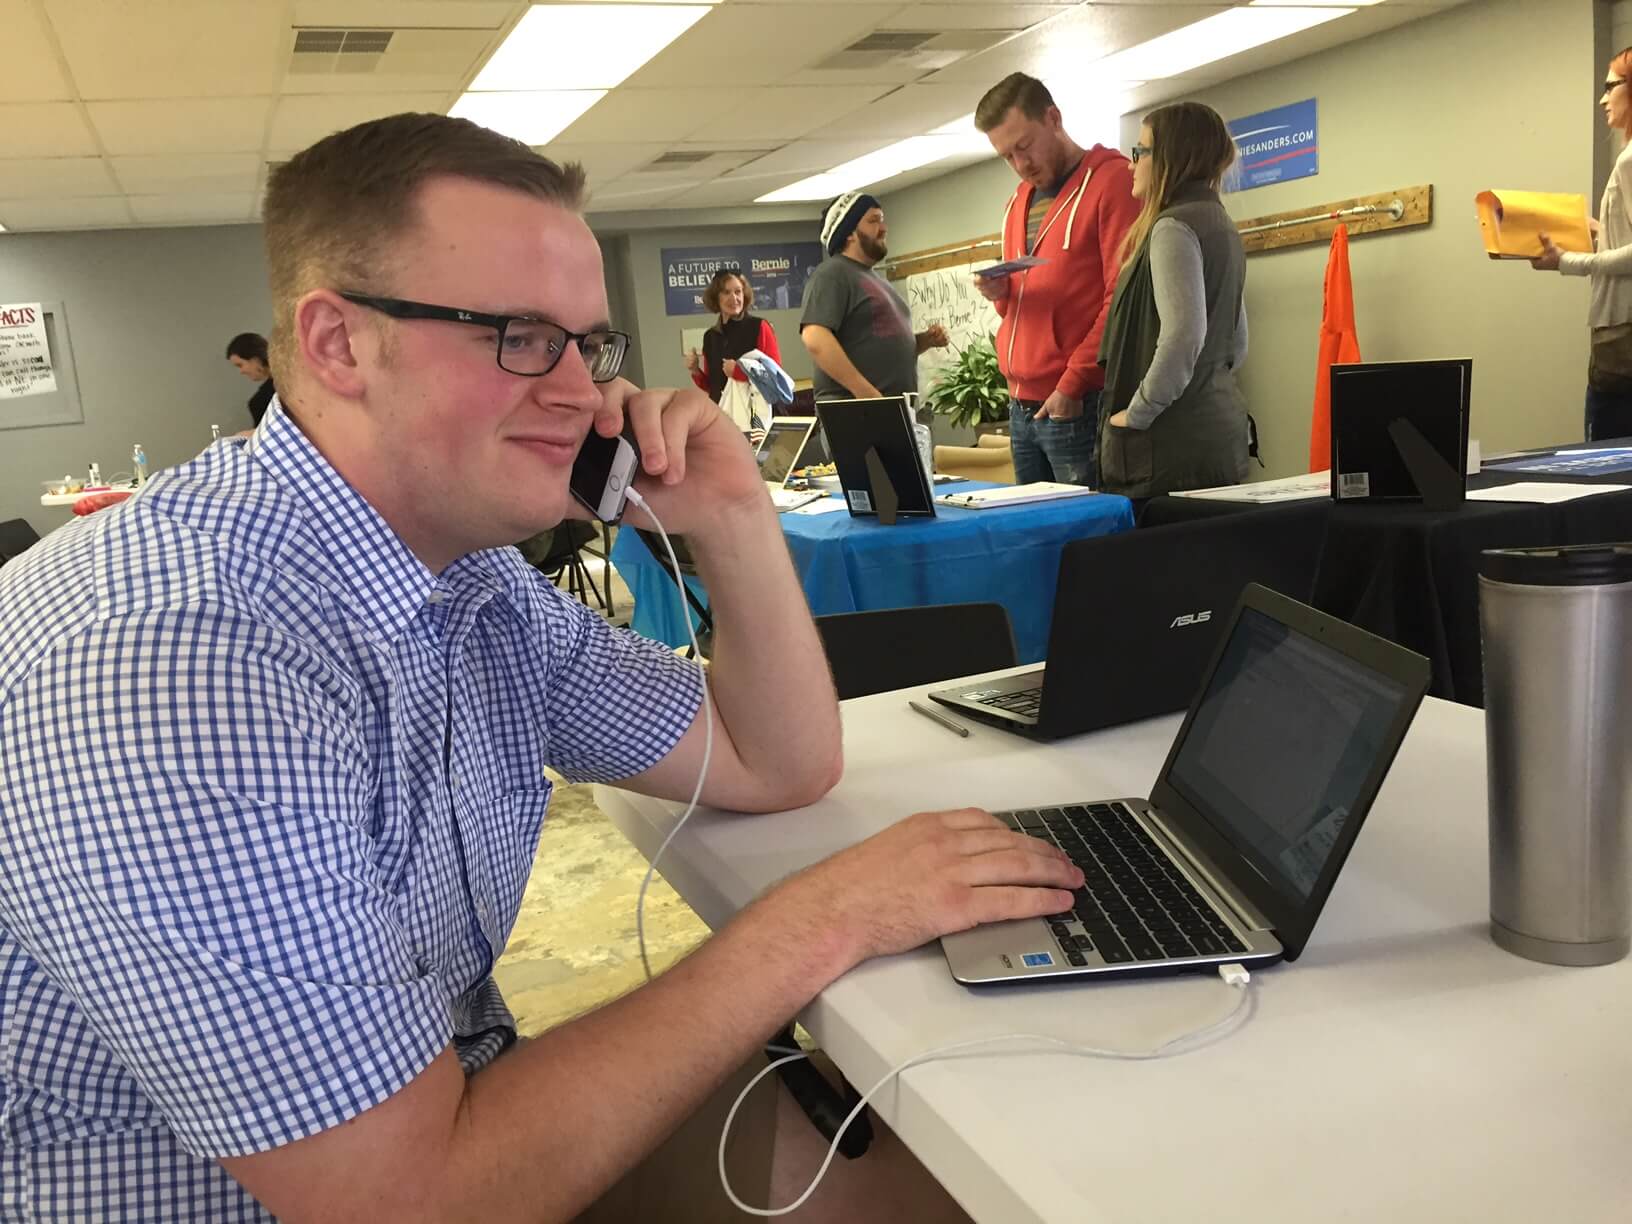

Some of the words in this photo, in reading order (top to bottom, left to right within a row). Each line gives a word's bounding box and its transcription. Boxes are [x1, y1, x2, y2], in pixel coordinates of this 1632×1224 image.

[667, 264, 676, 275] A
[678, 262, 721, 274] FUTURE
[725, 261, 740, 270] TO
[752, 257, 790, 270] Bernie
[669, 275, 715, 288] BELIEV
[0, 307, 35, 326] ACTS
[1169, 610, 1212, 629] ASUS
